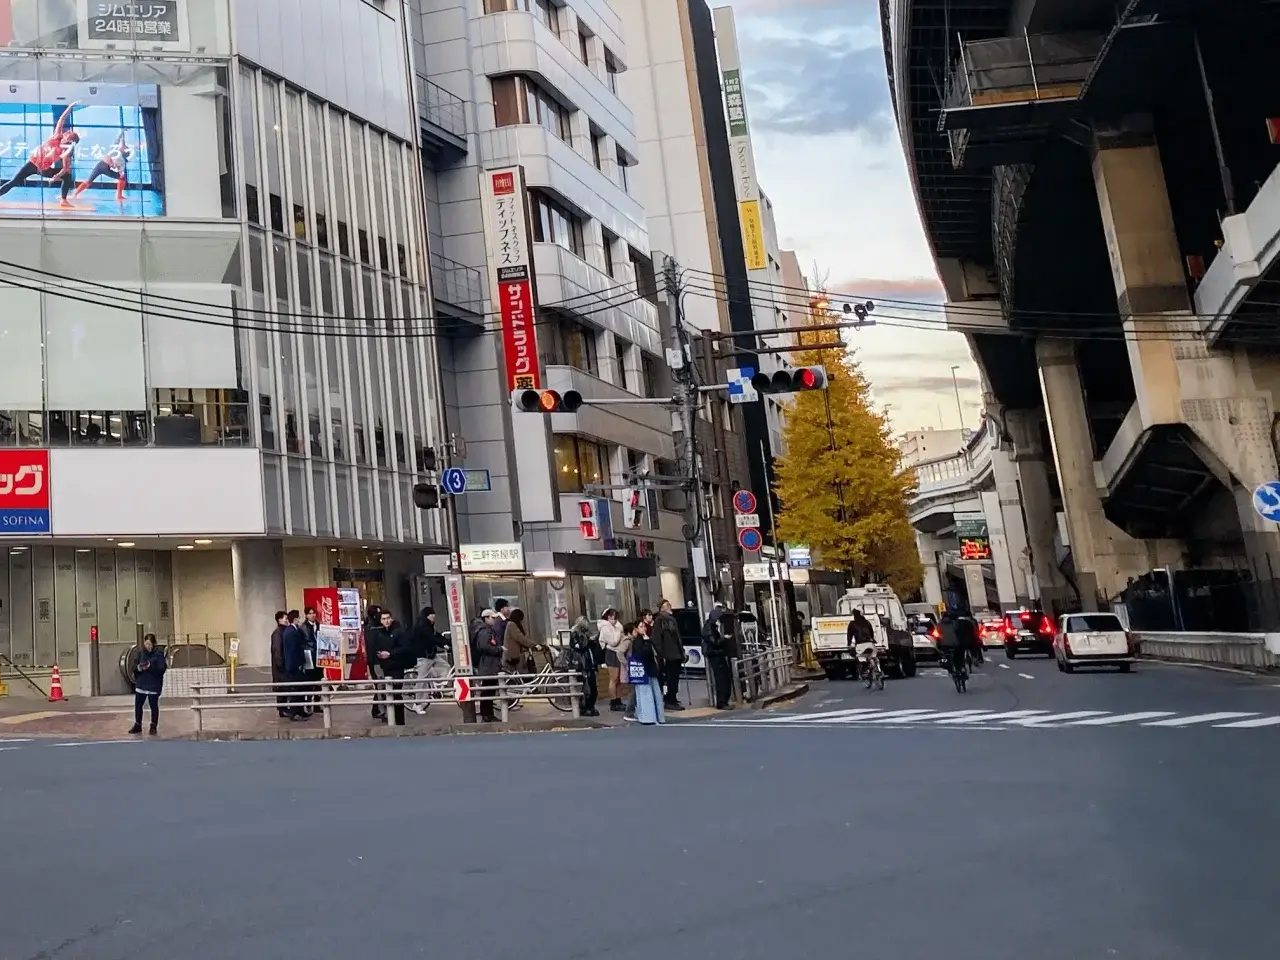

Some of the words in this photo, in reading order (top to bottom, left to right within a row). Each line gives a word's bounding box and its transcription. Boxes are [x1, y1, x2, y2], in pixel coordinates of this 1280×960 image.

[98, 3, 167, 18] ジムエリア
[95, 19, 172, 35] 24時間営業
[496, 198, 512, 264] ティップネス
[507, 284, 530, 373] サンドラッグ
[452, 472, 461, 489] 3
[2, 516, 44, 526] SOFINA
[472, 548, 519, 560] 三軒茶屋駅
